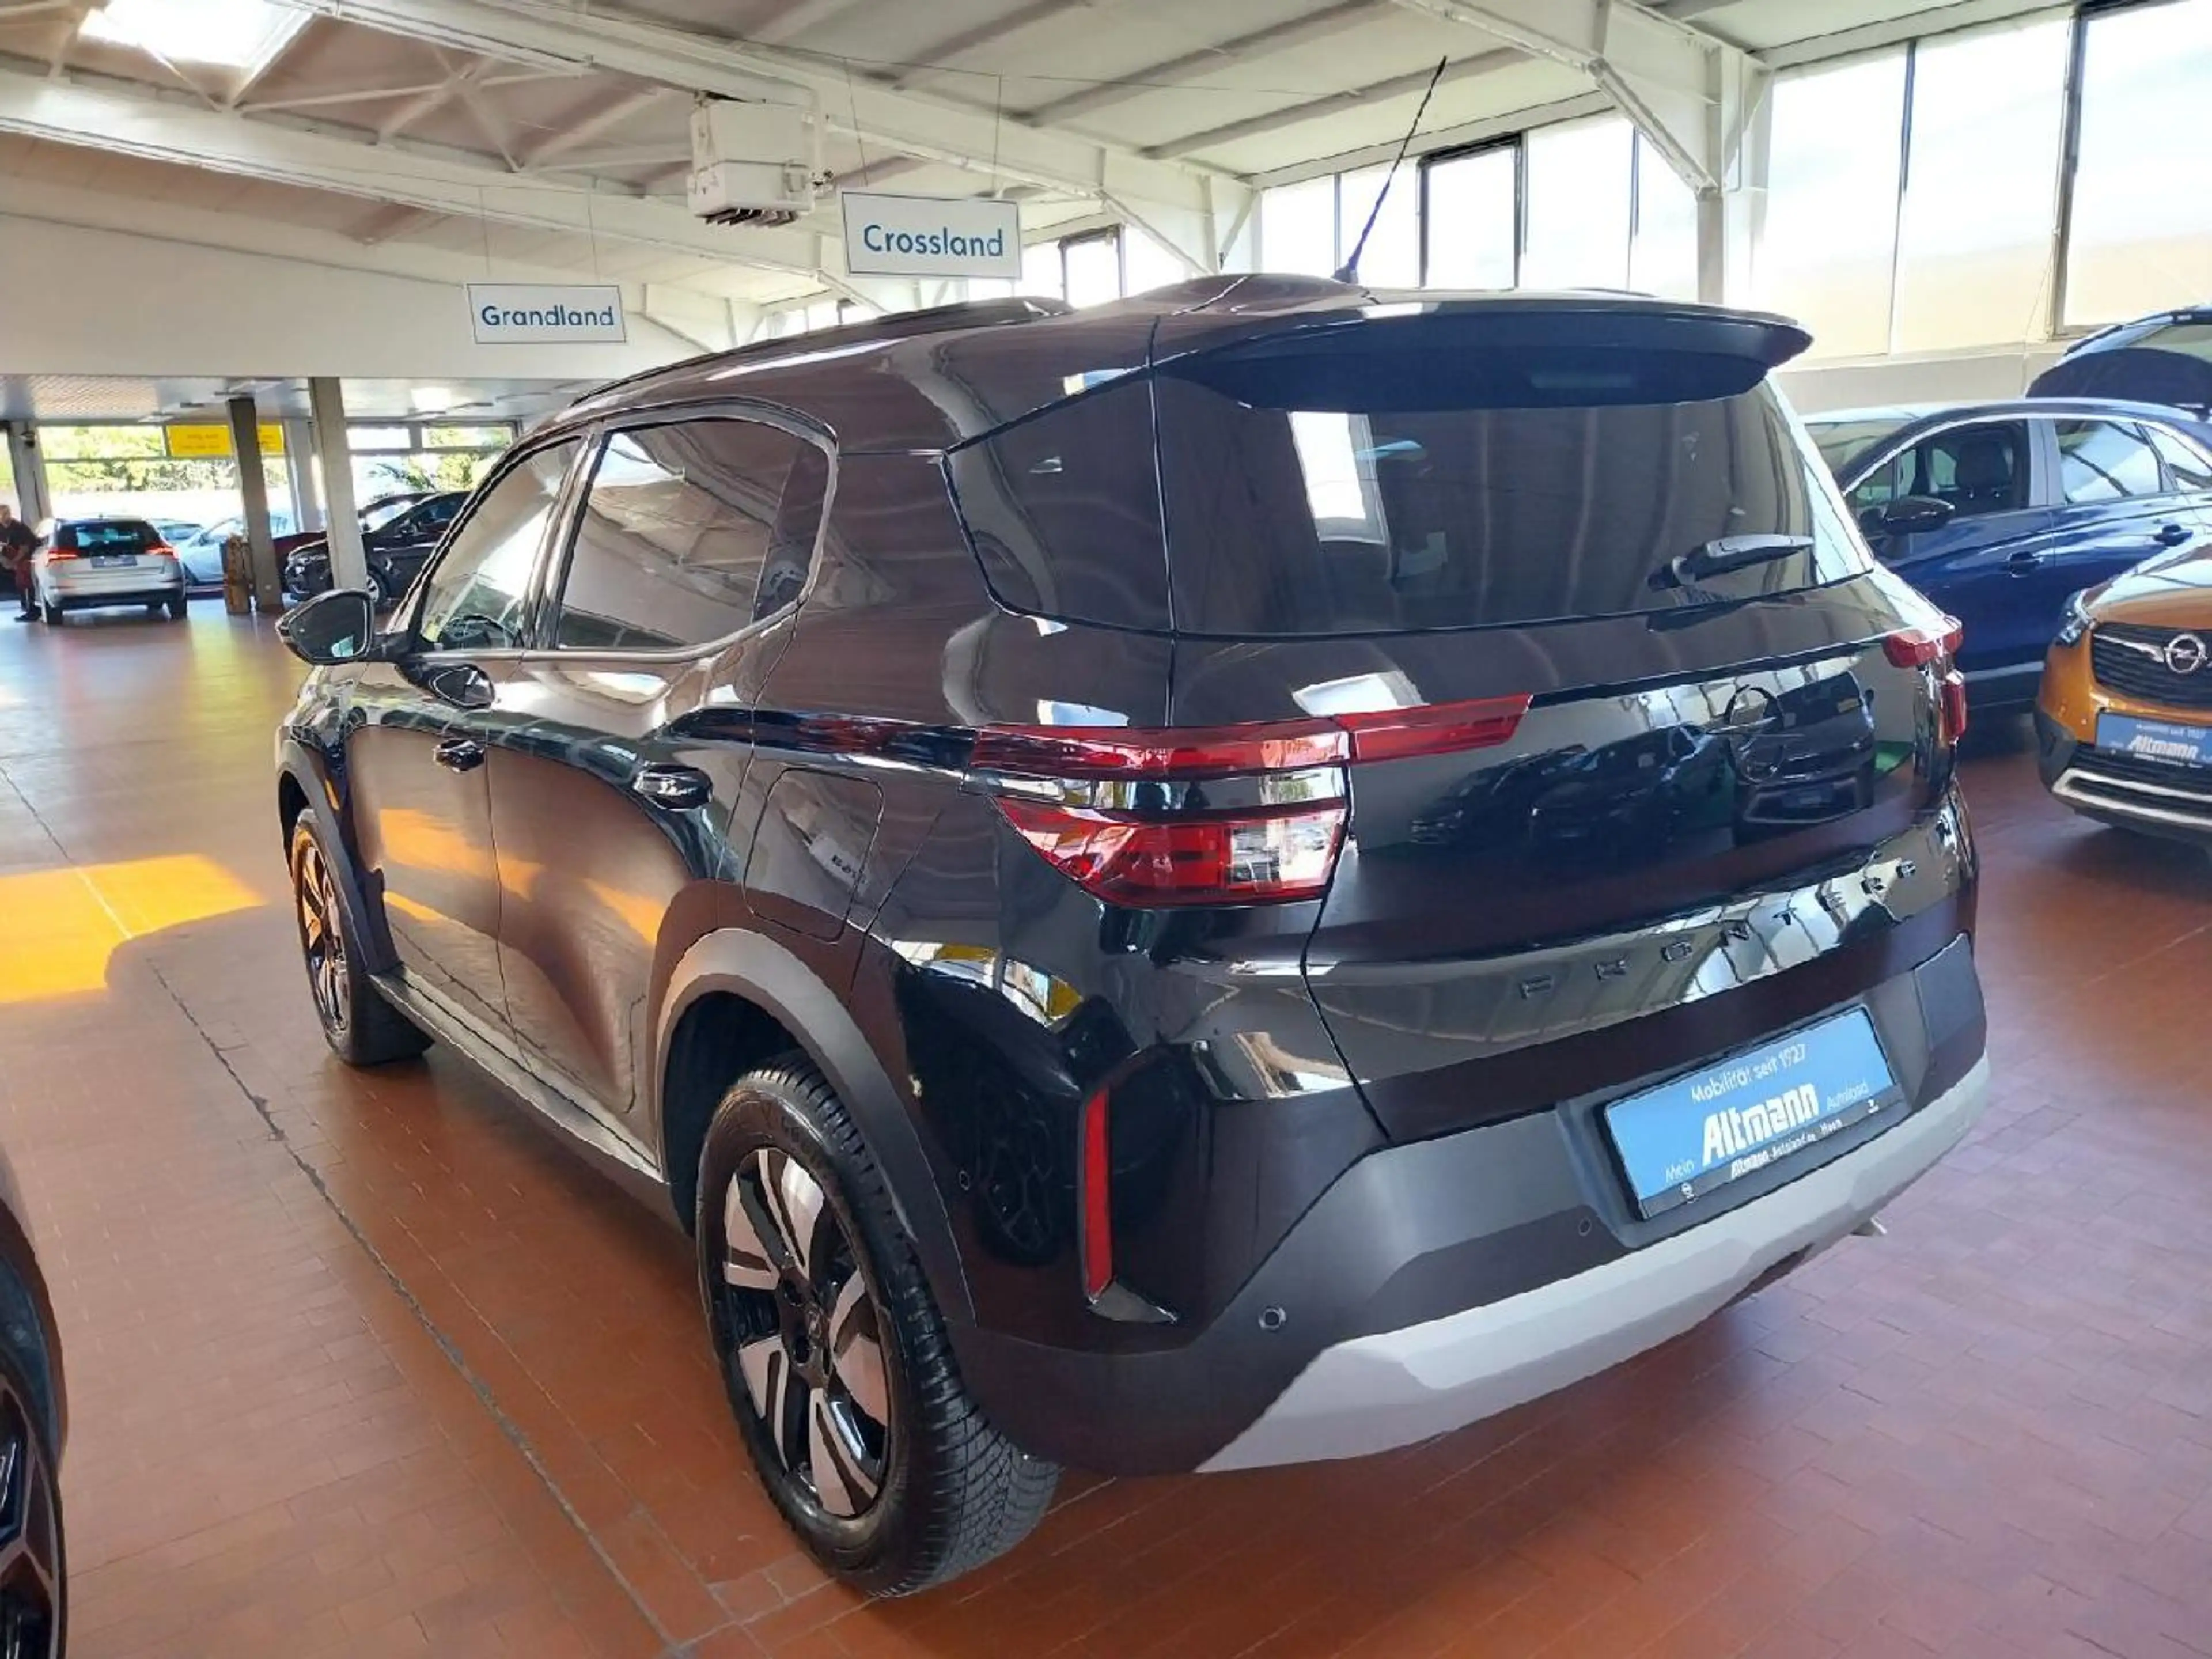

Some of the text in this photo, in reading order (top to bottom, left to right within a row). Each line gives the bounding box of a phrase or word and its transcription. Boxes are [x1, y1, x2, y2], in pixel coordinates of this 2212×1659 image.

[863, 224, 1003, 256] Crossland
[482, 305, 615, 326] Grandland
[1702, 1082, 1819, 1168] Altmann
